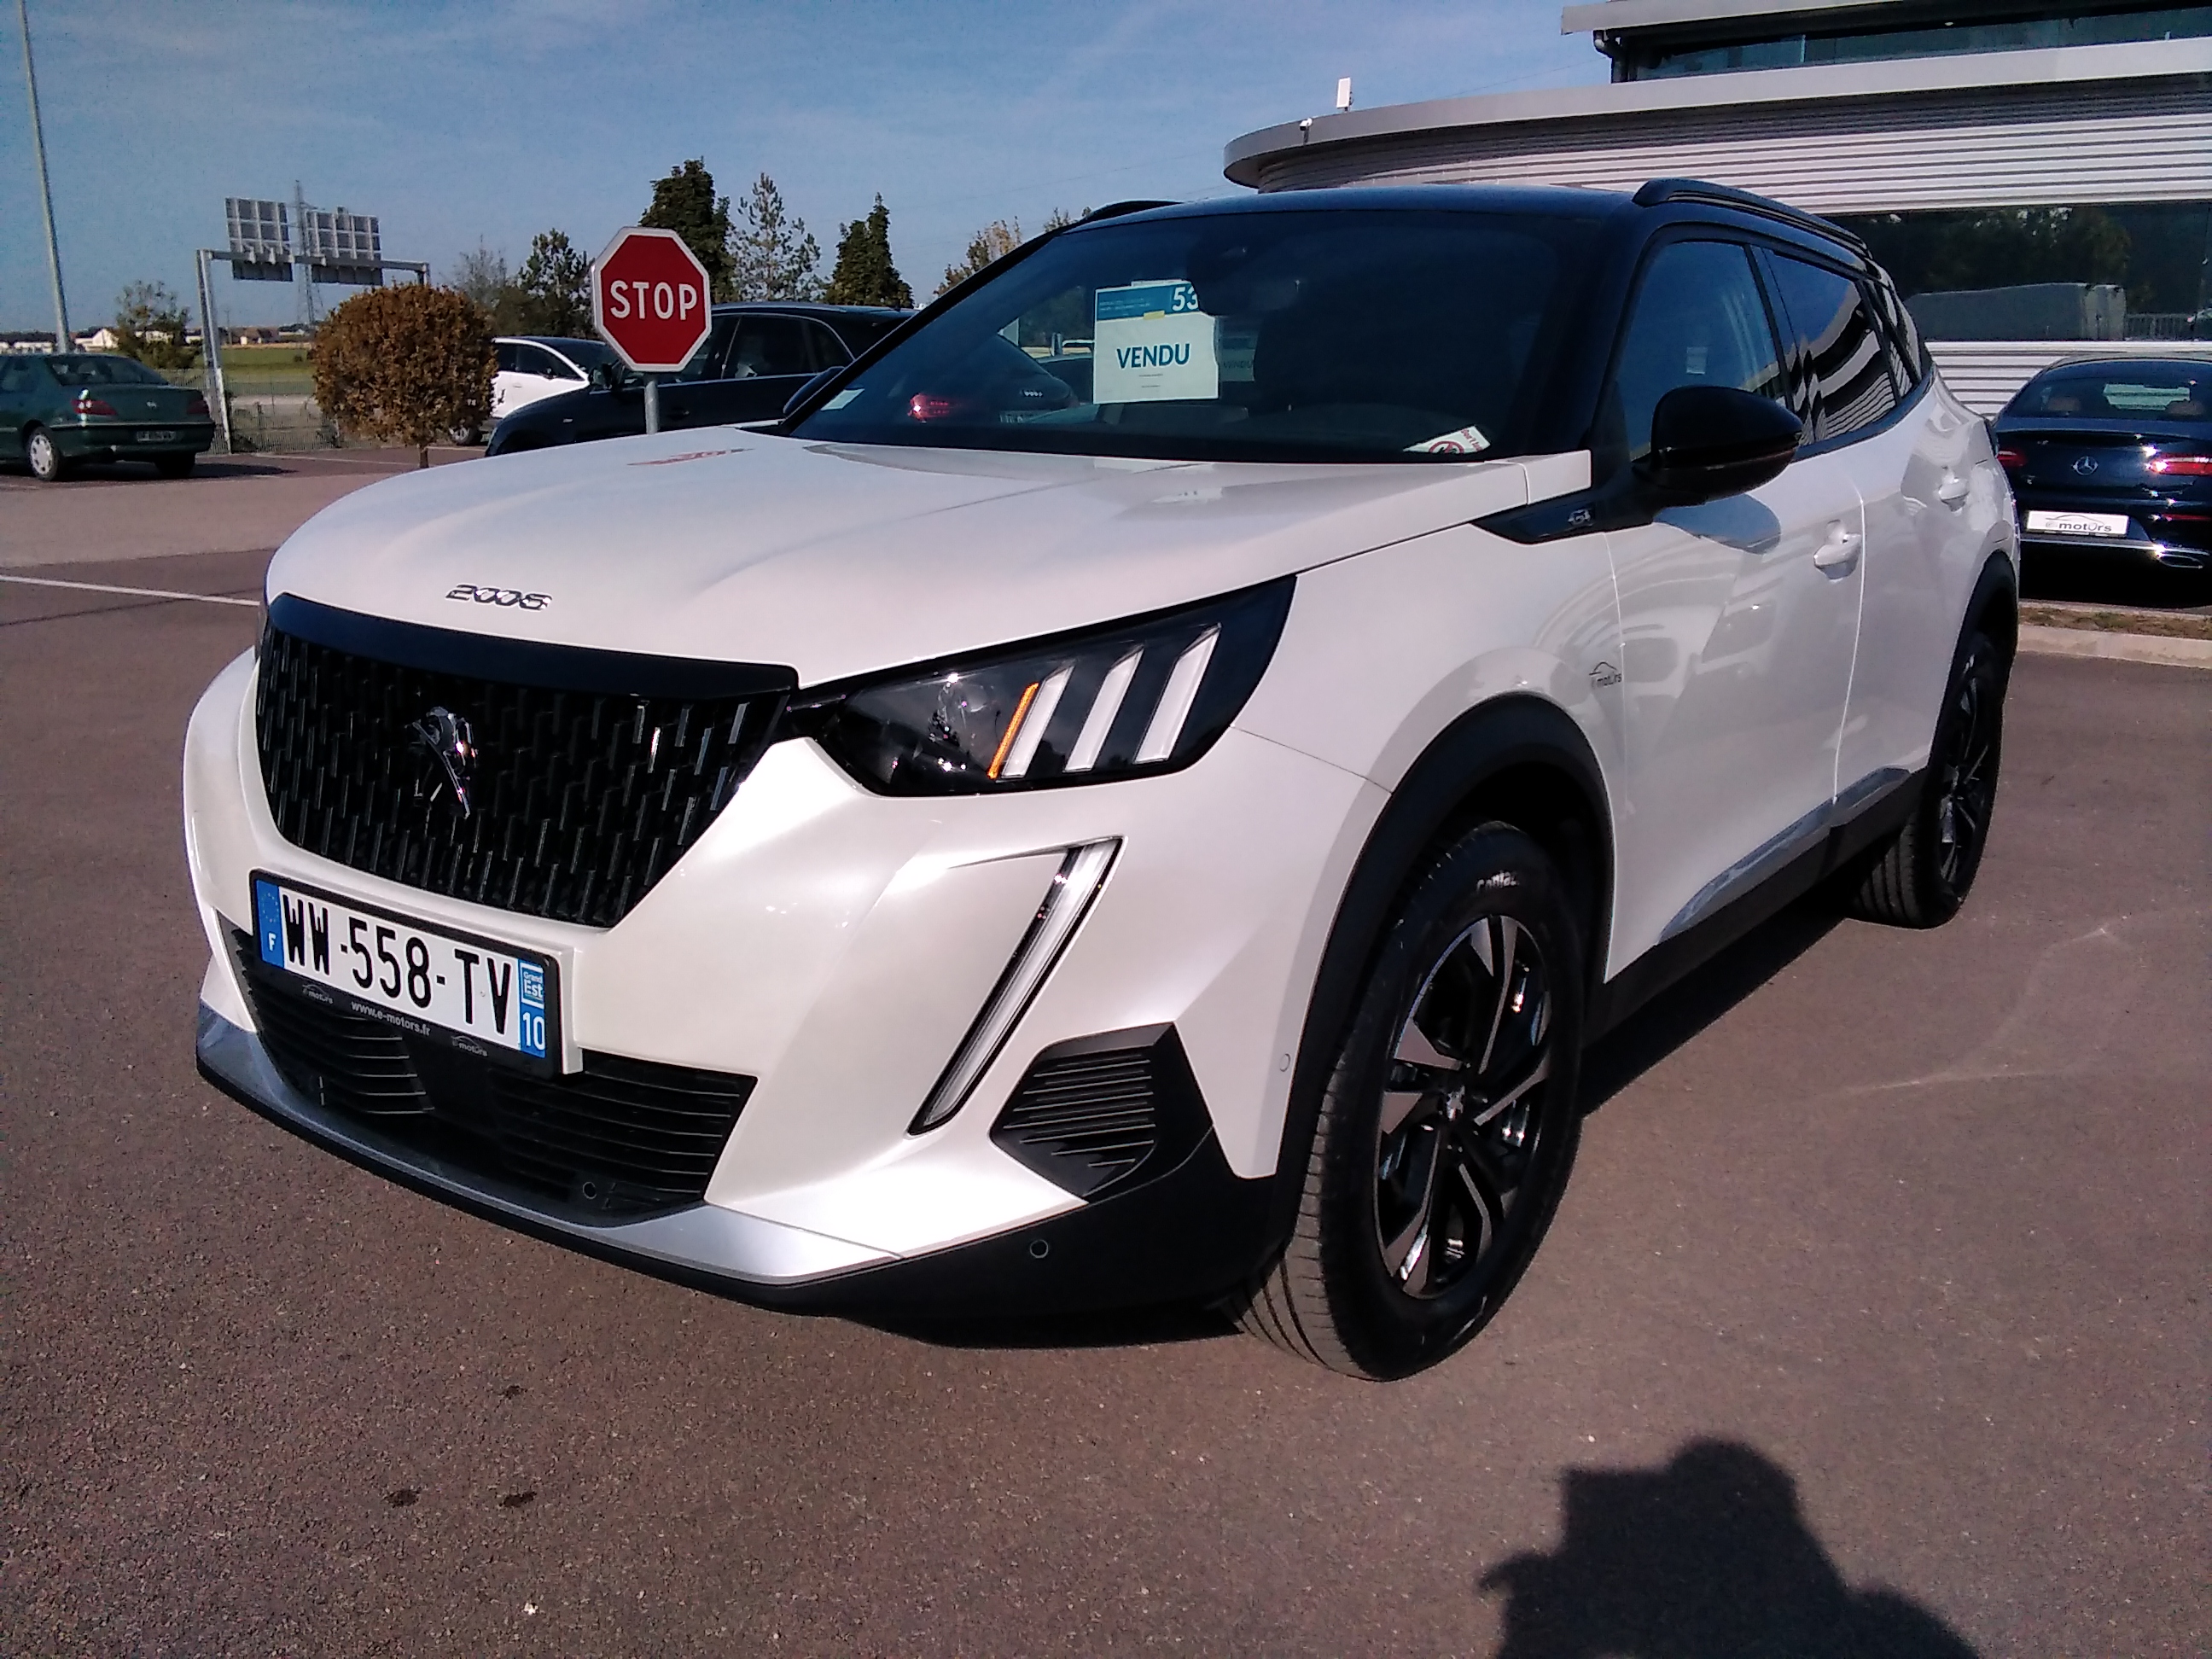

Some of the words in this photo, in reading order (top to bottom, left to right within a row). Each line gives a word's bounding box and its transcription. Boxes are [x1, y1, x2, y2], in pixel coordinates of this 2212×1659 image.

[610, 280, 697, 320] STOP
[1116, 343, 1190, 369] VENDU
[268, 933, 277, 952] F
[282, 893, 512, 1035] WW-558-TV
[524, 980, 544, 998] Est
[351, 1001, 431, 1036] www.e-motors.fr
[522, 1012, 545, 1051] 10
